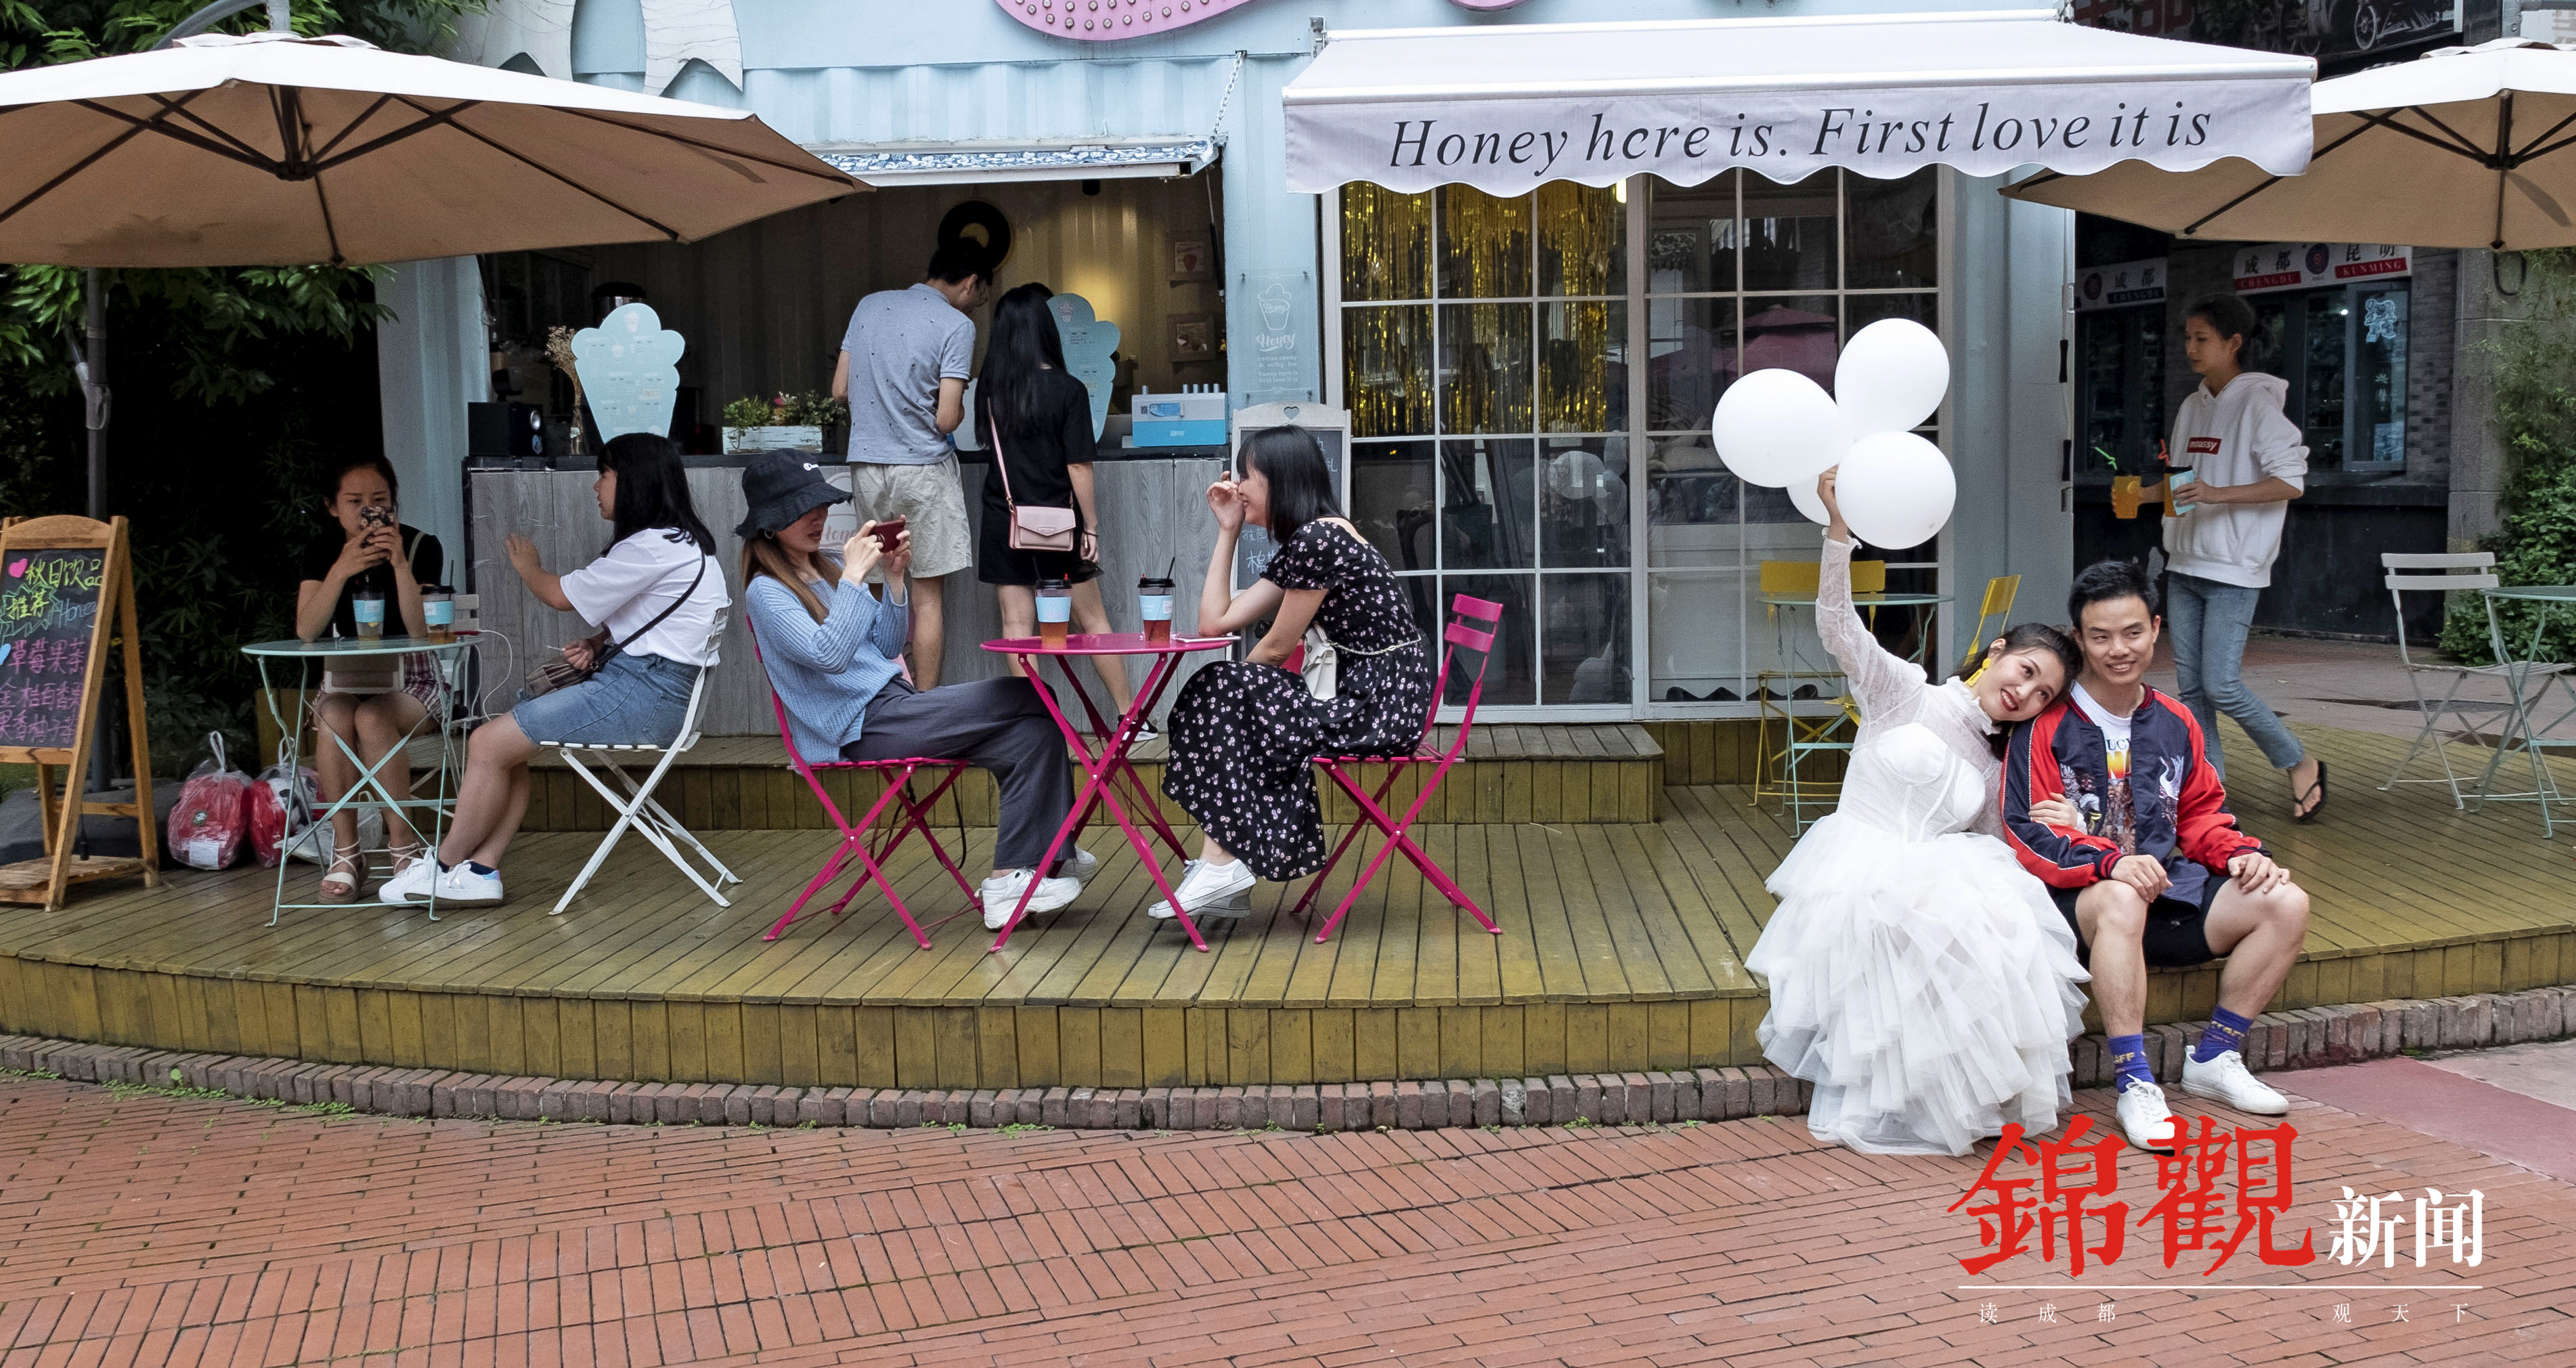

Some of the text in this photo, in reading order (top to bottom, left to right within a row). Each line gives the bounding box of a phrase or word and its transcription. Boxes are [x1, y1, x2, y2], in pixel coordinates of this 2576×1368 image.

[1390, 120, 1568, 176] Honey
[1730, 112, 1787, 156] is.
[1809, 108, 1955, 155] First
[1971, 102, 2091, 152] love
[2110, 102, 2149, 147] it
[2167, 102, 2211, 146] is
[2244, 250, 2291, 275] 成都
[2342, 261, 2401, 276] KUNMING
[2240, 274, 2294, 289] CHENGDU
[25, 554, 104, 591] 秋日饮品
